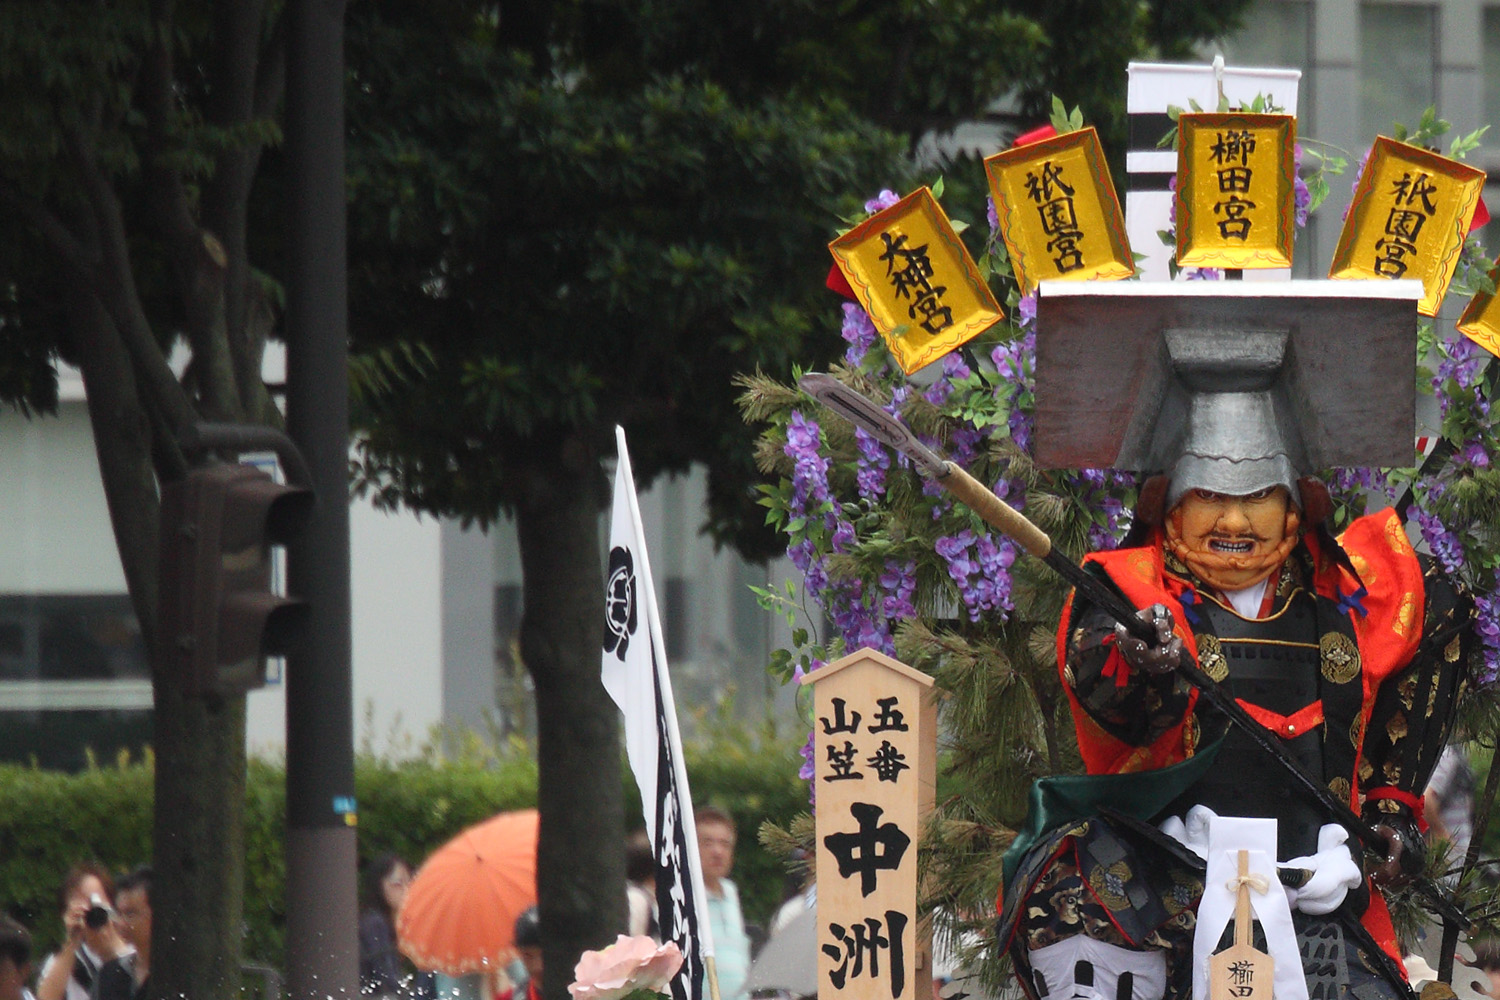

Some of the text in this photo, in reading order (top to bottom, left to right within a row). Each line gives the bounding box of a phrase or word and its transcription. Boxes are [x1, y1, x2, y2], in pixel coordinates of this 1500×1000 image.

[1208, 130, 1256, 241] 櫛田宮
[879, 232, 954, 335] 大神宮
